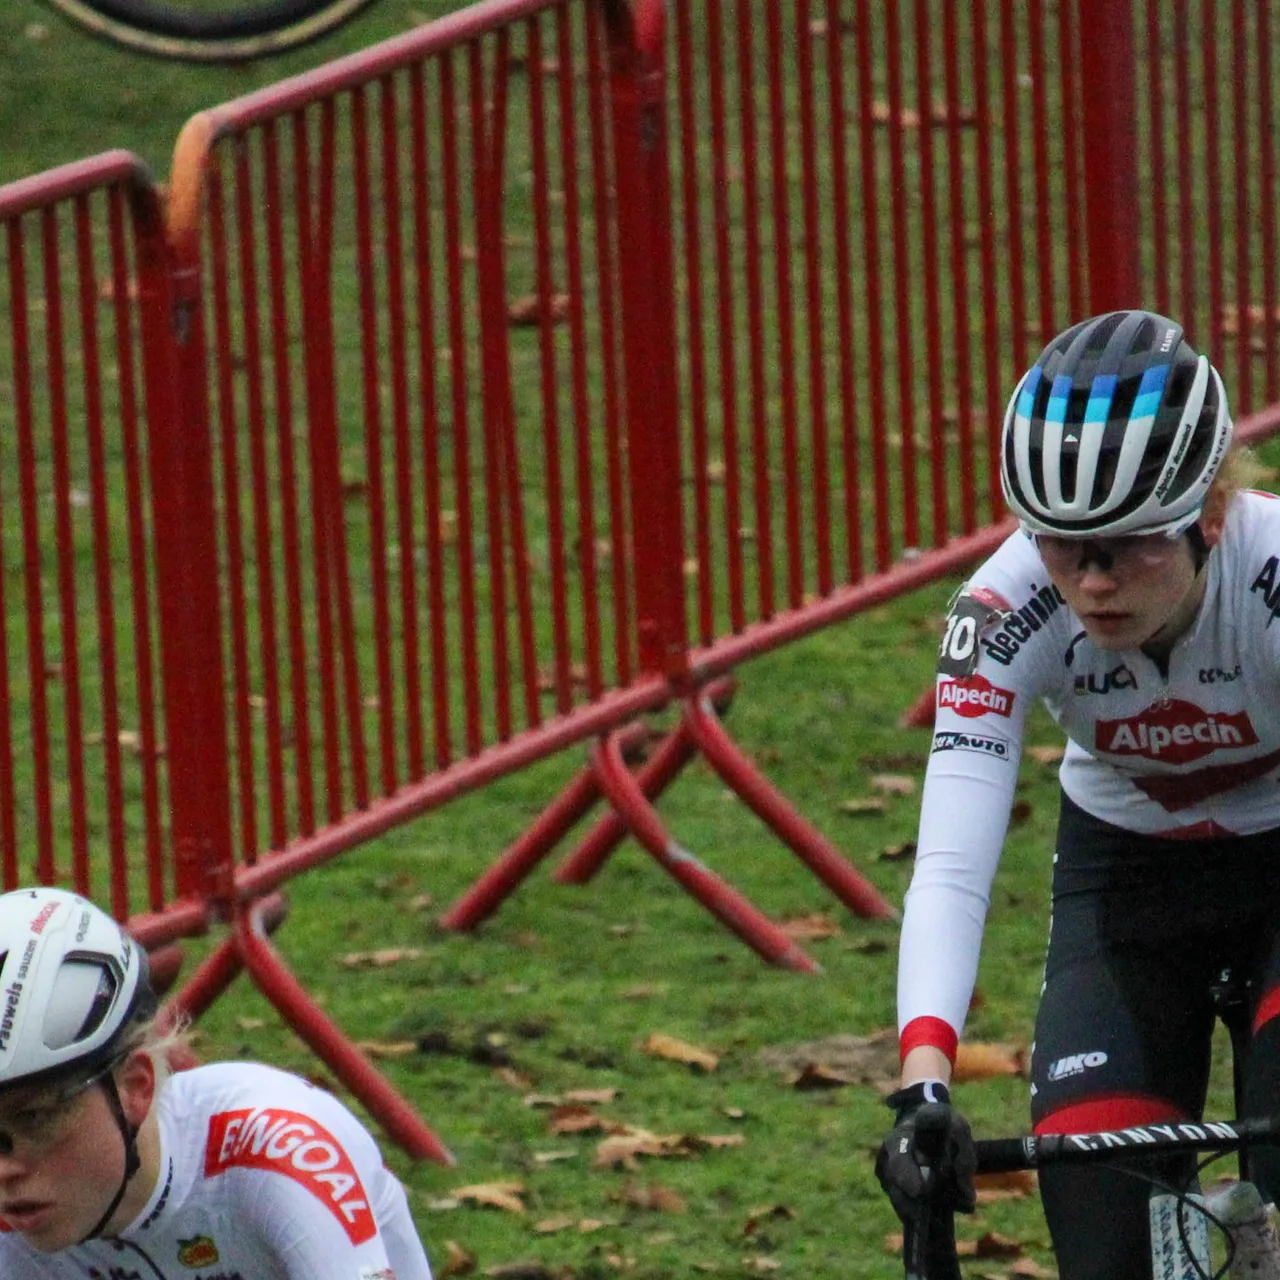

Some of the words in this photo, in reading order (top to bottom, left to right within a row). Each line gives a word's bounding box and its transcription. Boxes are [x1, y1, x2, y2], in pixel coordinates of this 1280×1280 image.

[941, 615, 977, 661] 10
[980, 583, 1067, 666] deceunin
[941, 684, 1008, 713] Alpecin
[1109, 717, 1244, 755] Alpecin
[17, 938, 38, 980] sauzen
[1071, 1121, 1240, 1151] CANYON
[219, 1107, 367, 1225] BINGOAL
